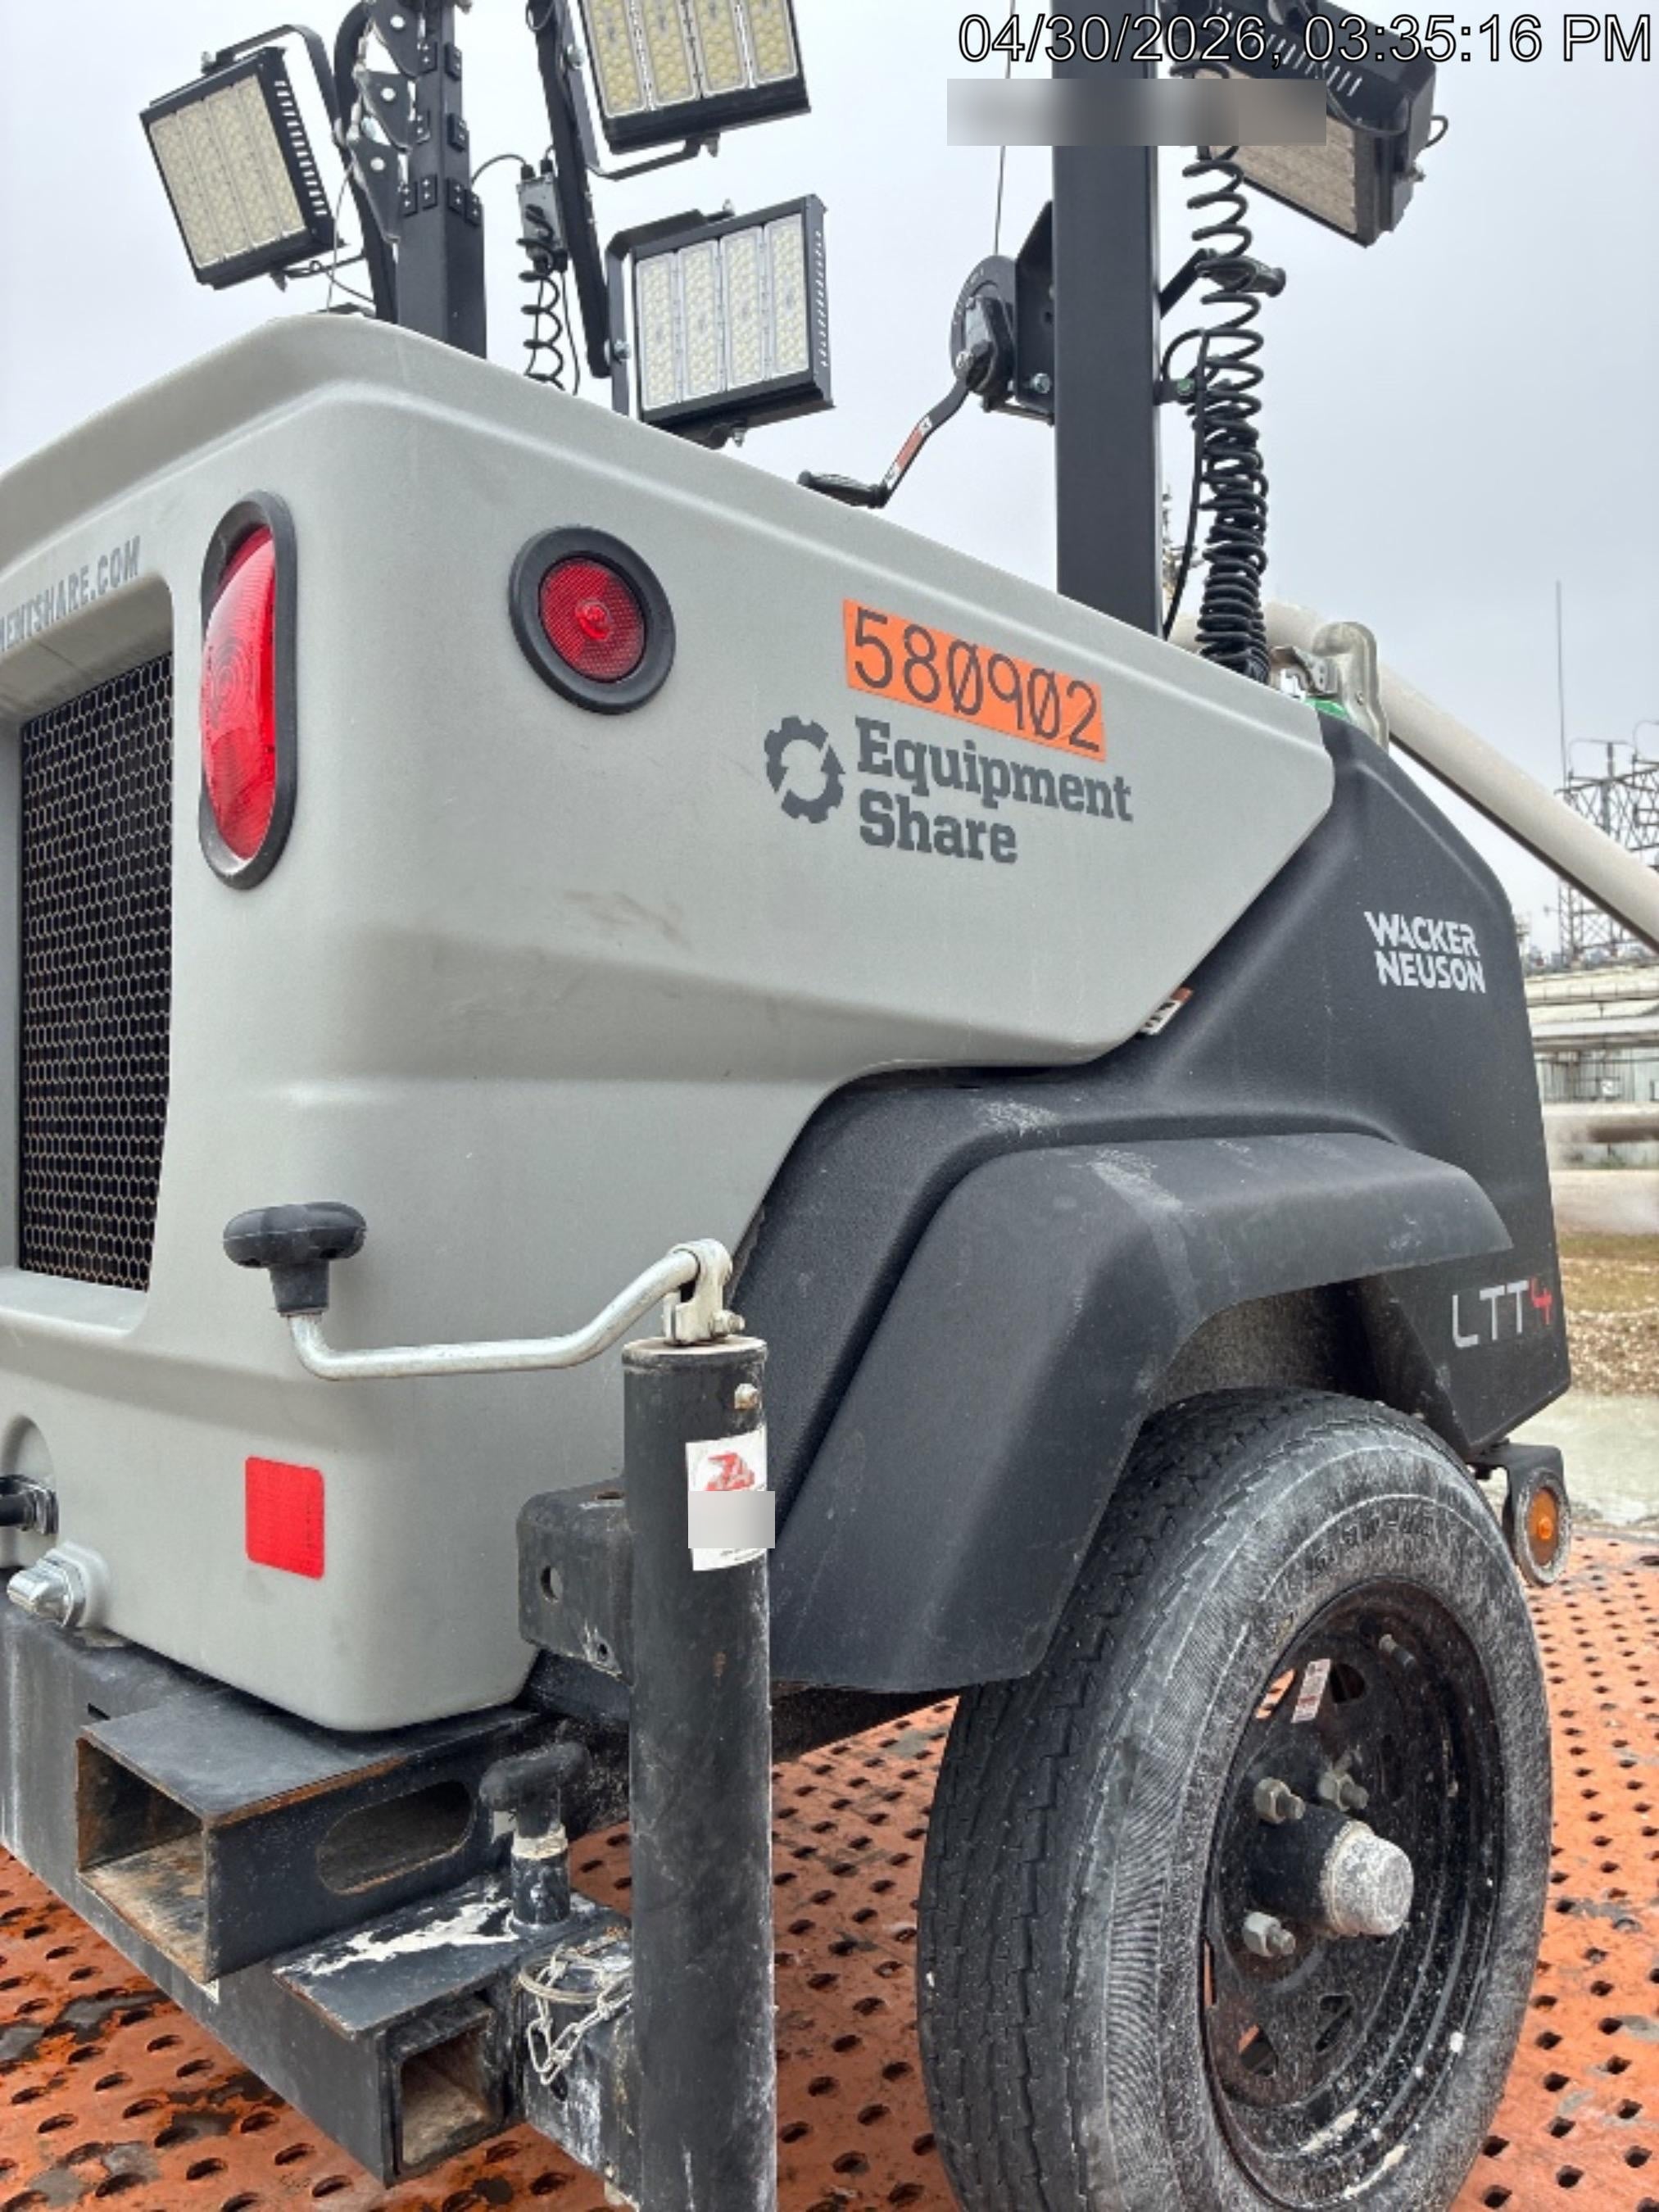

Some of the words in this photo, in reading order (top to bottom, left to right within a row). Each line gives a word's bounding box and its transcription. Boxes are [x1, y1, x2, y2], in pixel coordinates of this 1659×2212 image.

[854, 605, 1100, 752] 580902
[854, 714, 1134, 823] Equipment
[859, 787, 1018, 865] Share
[1363, 910, 1481, 958] WACKER
[1373, 950, 1487, 995] NEUSON
